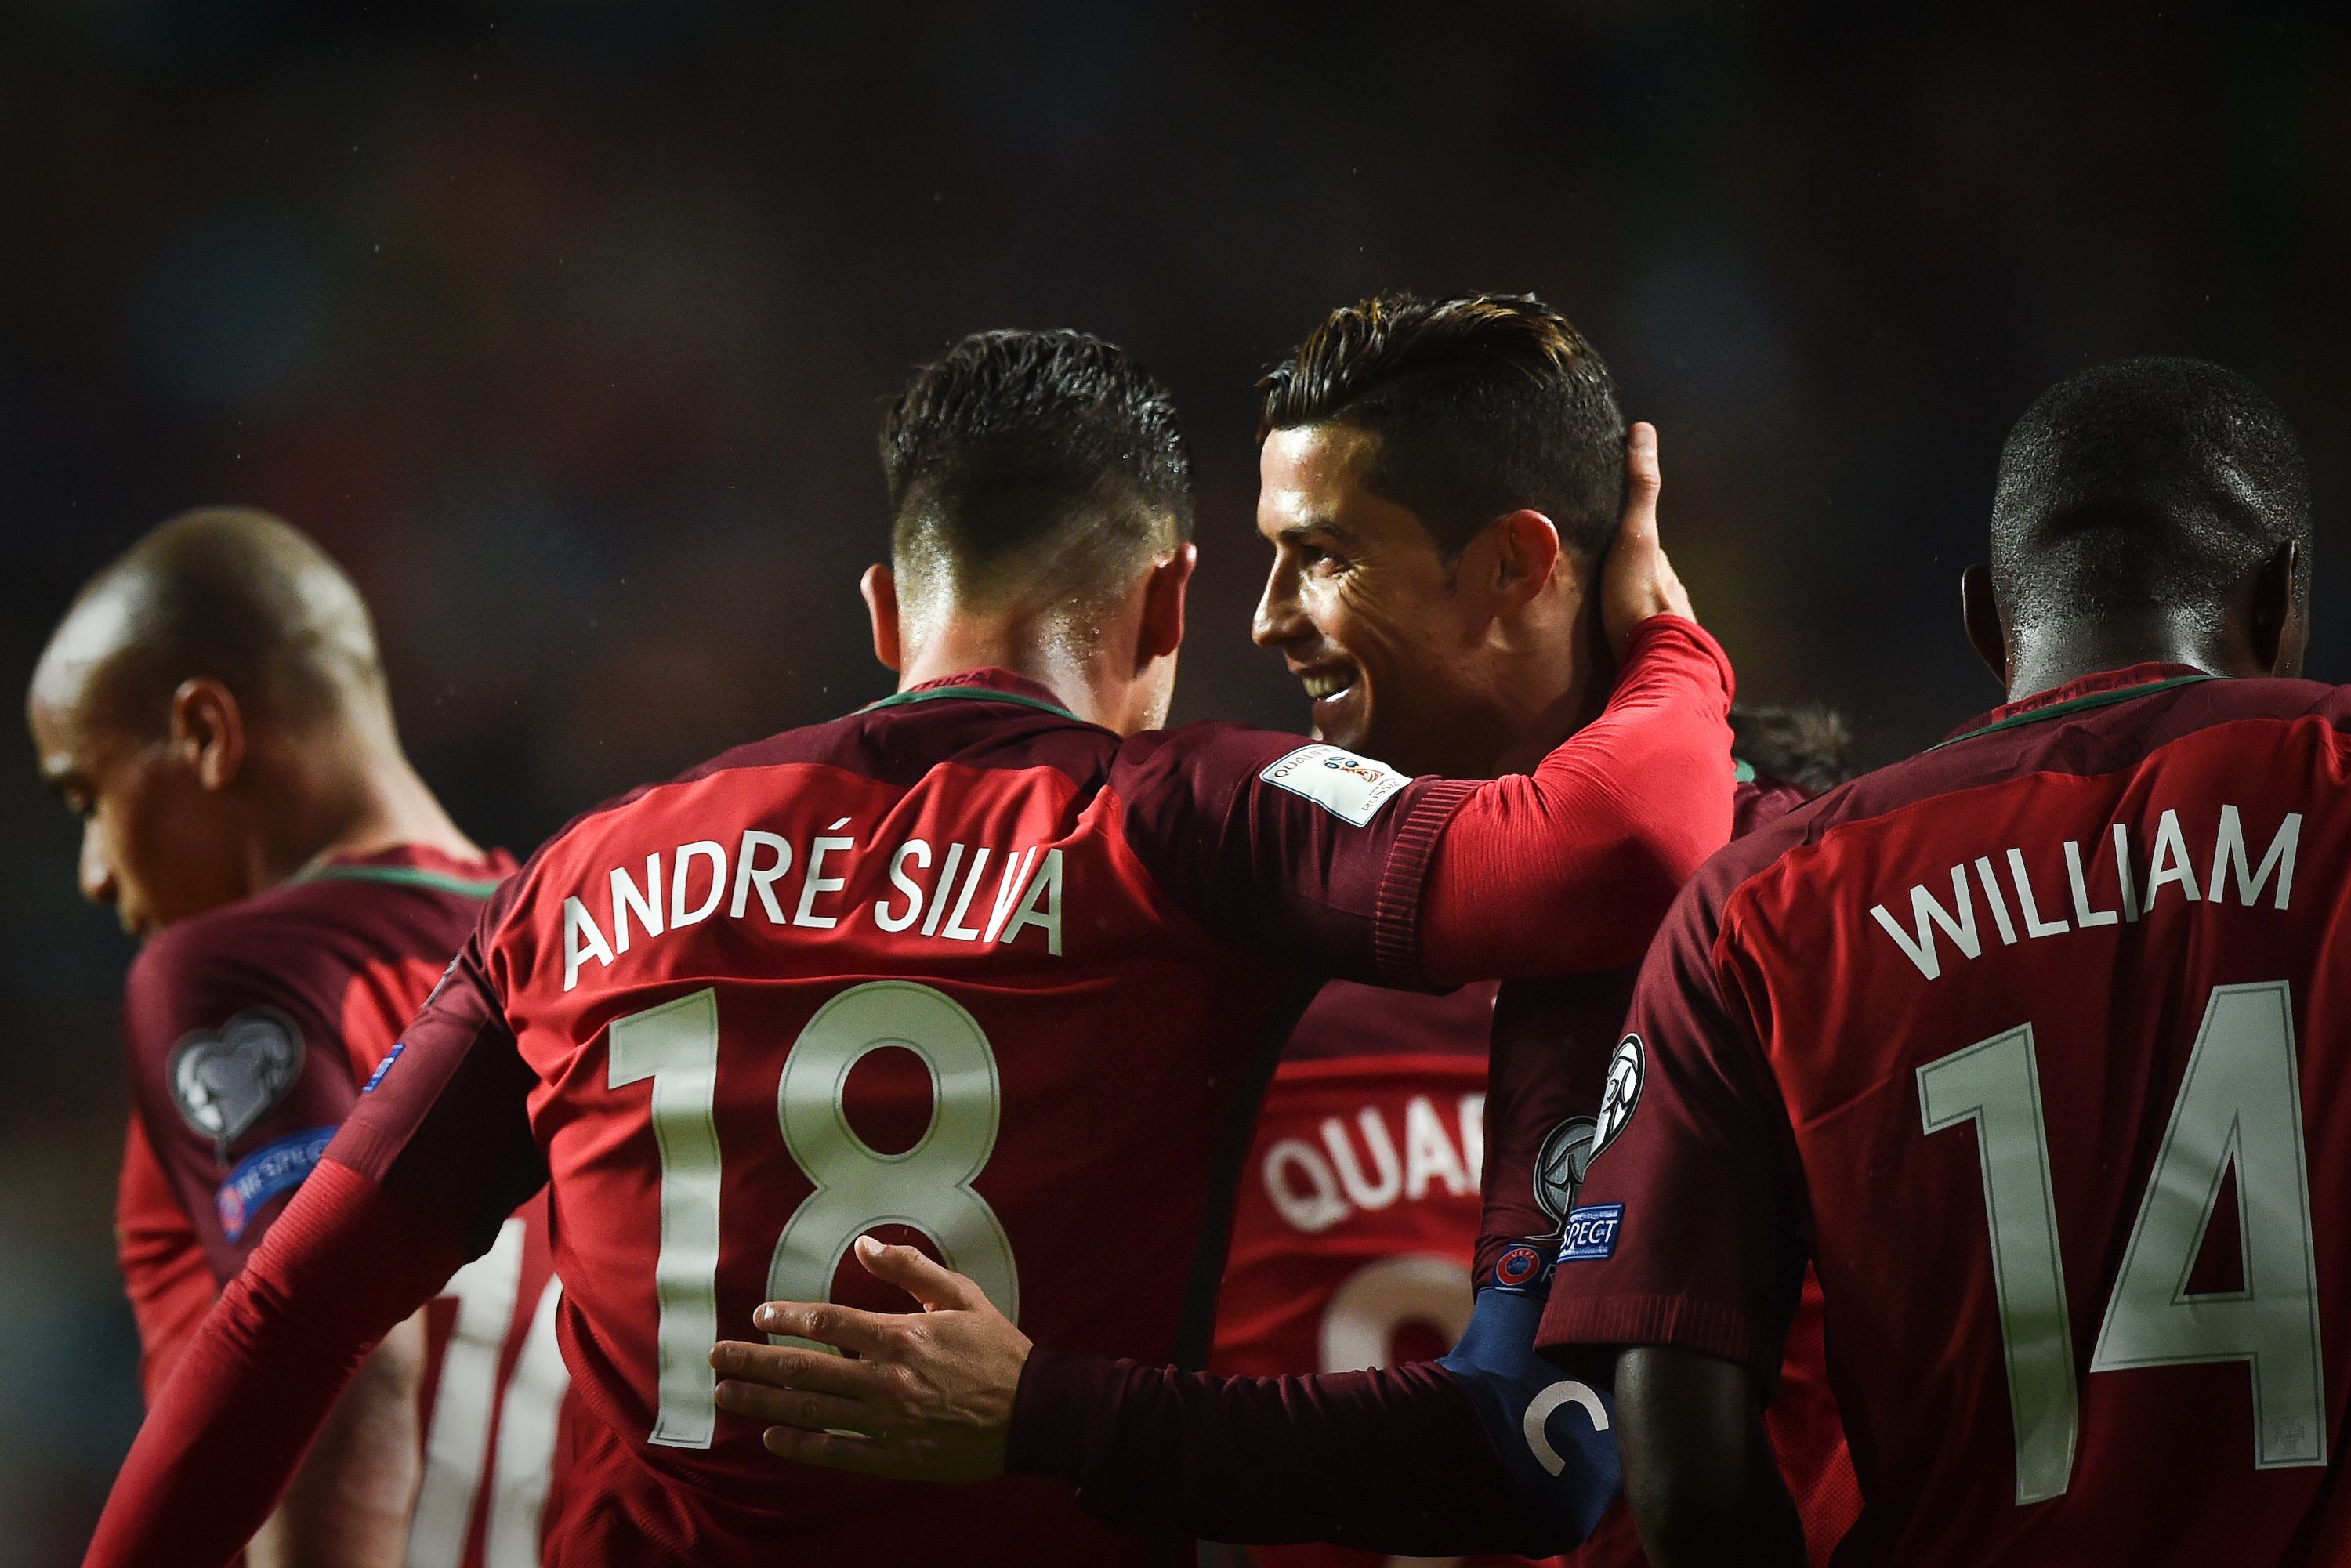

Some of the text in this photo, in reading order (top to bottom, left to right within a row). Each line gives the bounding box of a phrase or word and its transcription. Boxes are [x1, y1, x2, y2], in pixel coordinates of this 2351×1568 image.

[563, 817, 1063, 992] ANDRÉ SILVA
[1869, 804, 2302, 981] WILLIAM
[608, 980, 1020, 1450] 18
[1916, 980, 2328, 1506] 14
[1523, 1380, 1610, 1478] C
